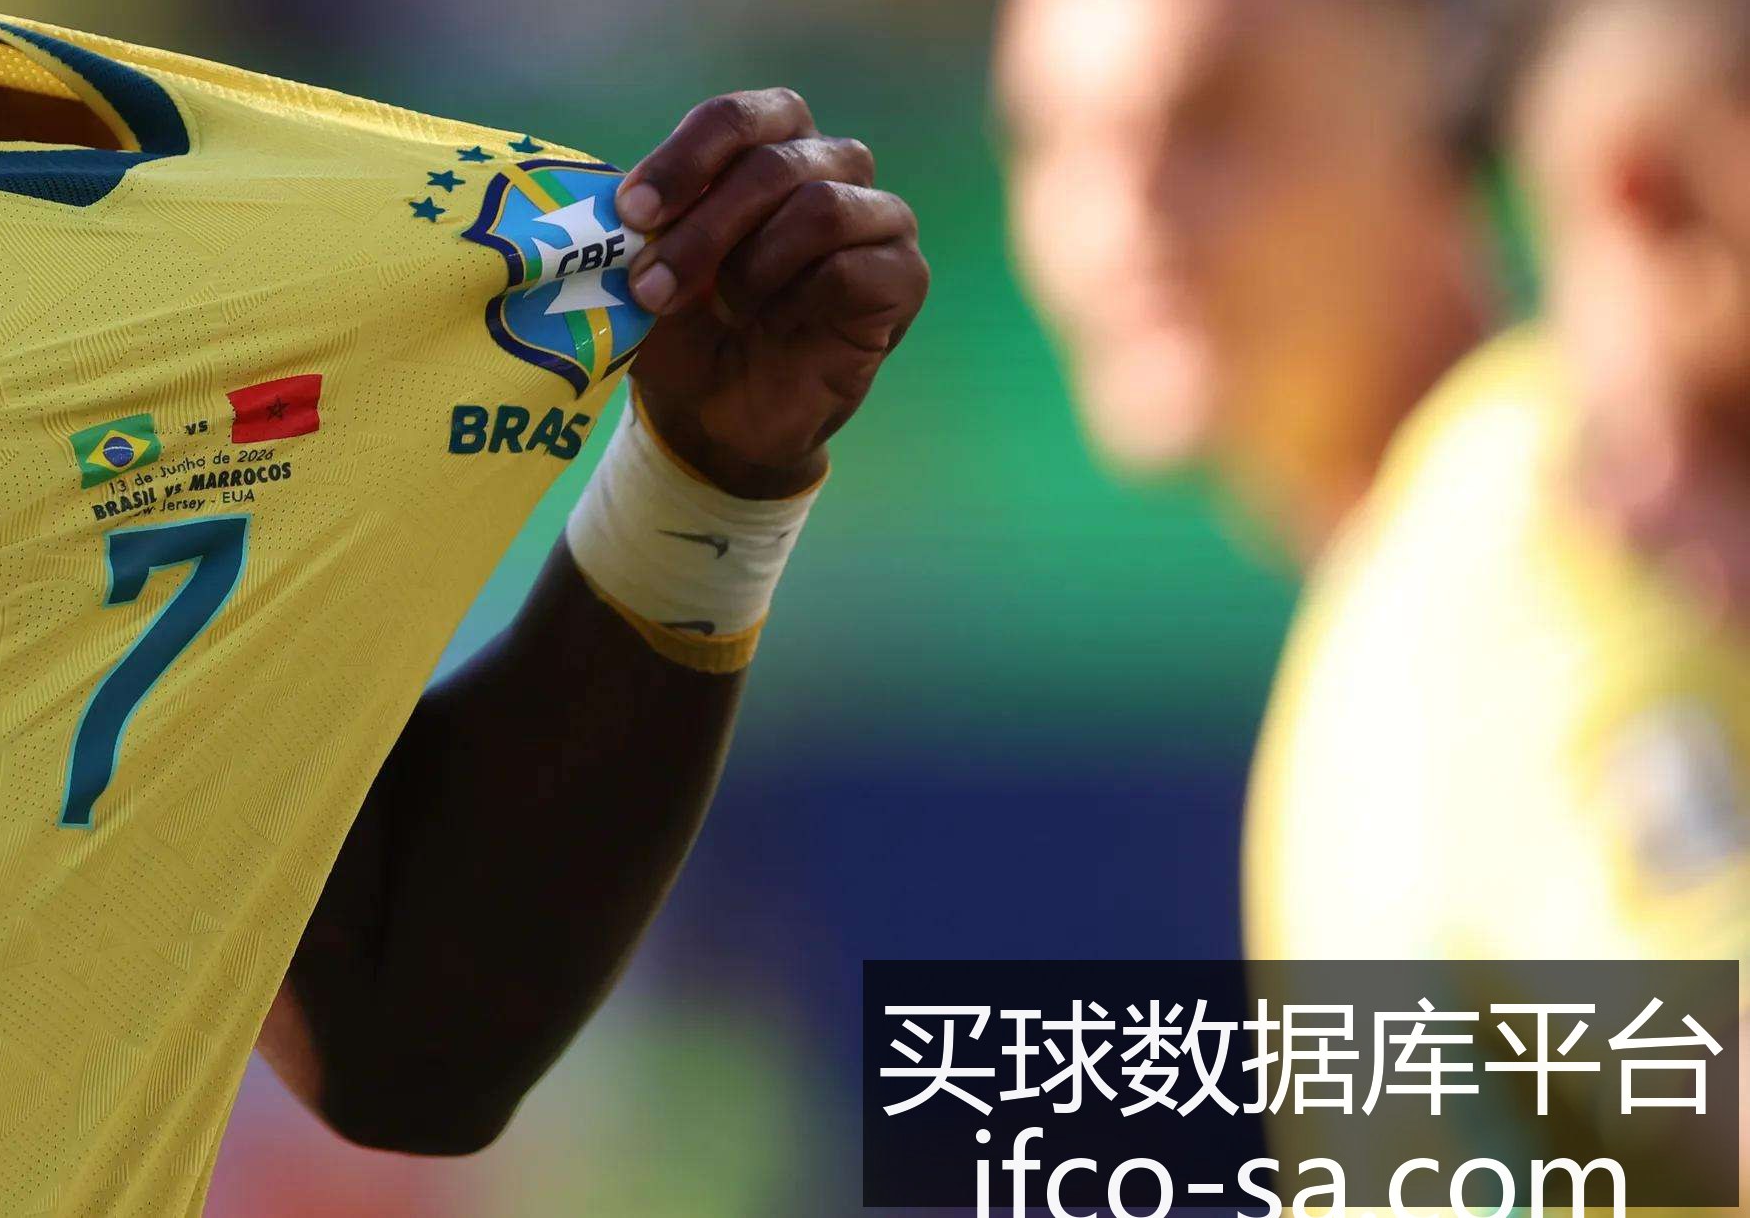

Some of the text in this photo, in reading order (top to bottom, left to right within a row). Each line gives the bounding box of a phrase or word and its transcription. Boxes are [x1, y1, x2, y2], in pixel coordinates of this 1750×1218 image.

[556, 234, 626, 279] CBF
[185, 419, 208, 436] vs
[91, 486, 158, 521] BRASIL
[164, 483, 182, 498] vs
[188, 461, 292, 491] MARROCOS
[109, 479, 128, 494] 13
[135, 473, 153, 486] de
[212, 451, 231, 465] de
[236, 447, 276, 464] 2026
[222, 489, 256, 504] EUA
[58, 513, 251, 830] 7
